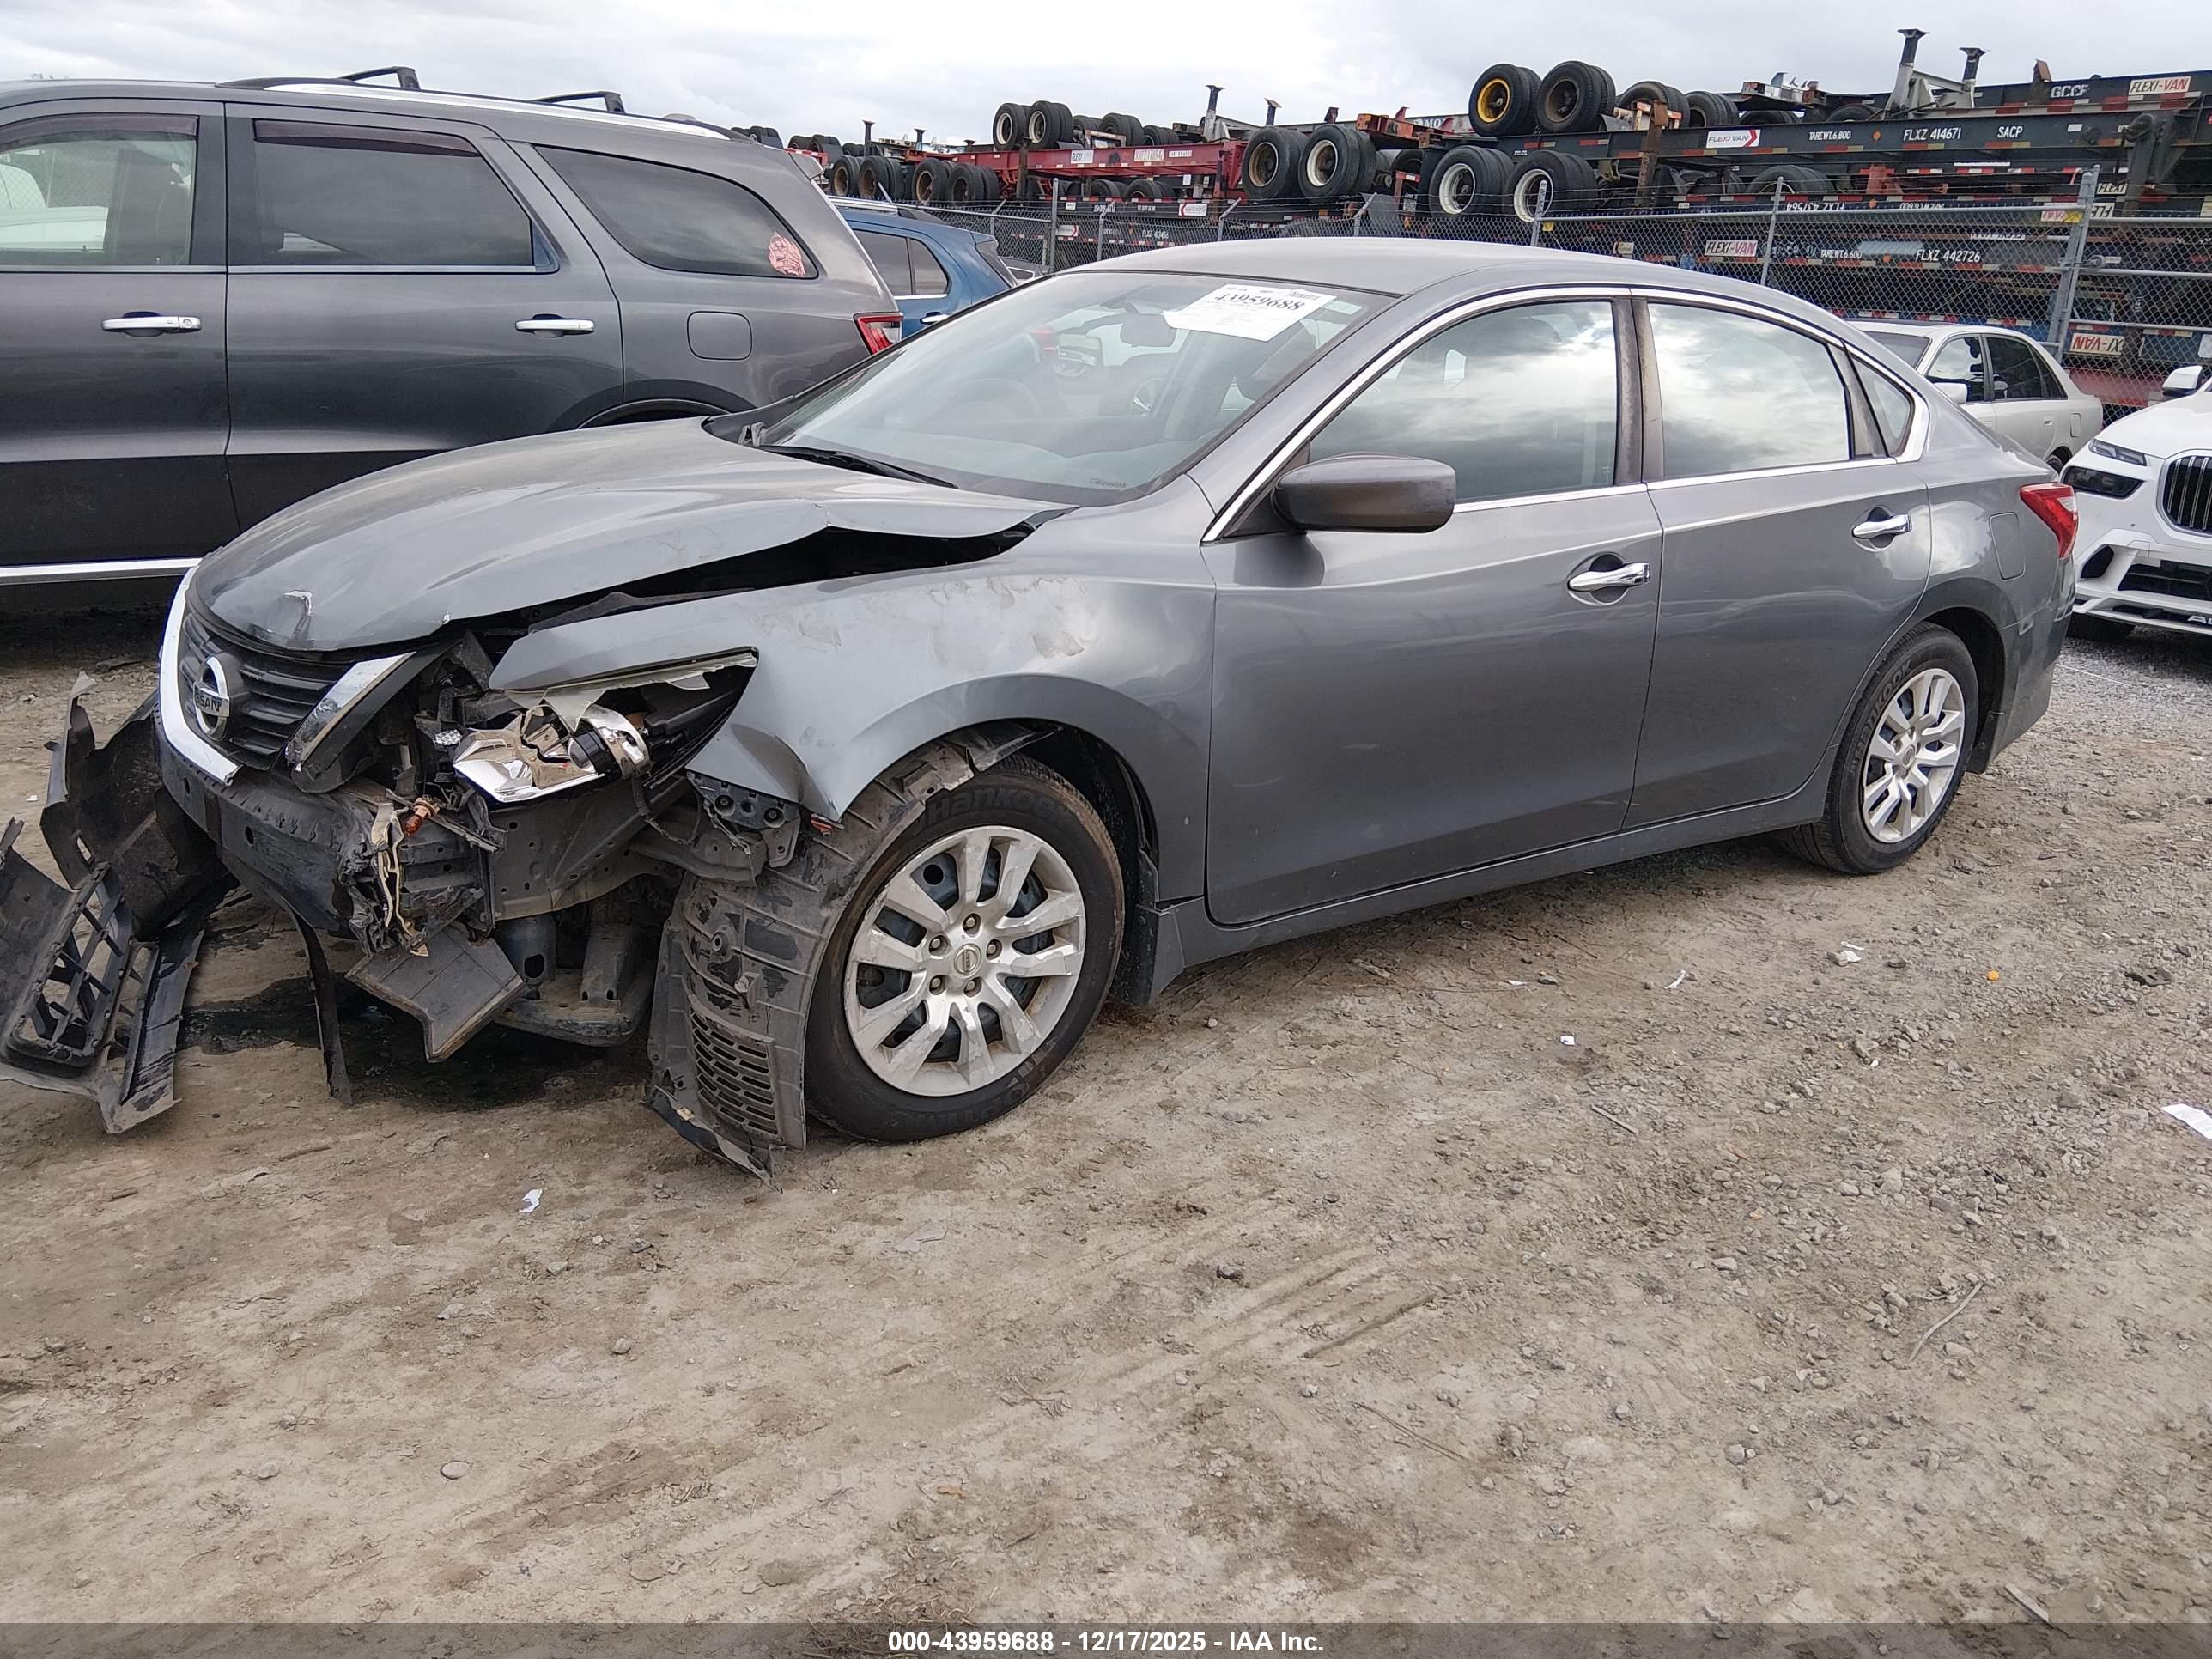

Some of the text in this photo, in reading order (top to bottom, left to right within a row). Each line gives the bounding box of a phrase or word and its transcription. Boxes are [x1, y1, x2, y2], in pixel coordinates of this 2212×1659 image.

[2130, 79, 2189, 97] FLEXI-VAN
[1903, 127, 1962, 141] FLXZ 414671
[1997, 126, 2023, 138] SACP
[1706, 241, 1756, 257] FLEXI-VAN
[1916, 250, 1980, 263] FLXZ 442726
[1214, 293, 1305, 311] 43959688
[2072, 336, 2124, 353] XI-VAN
